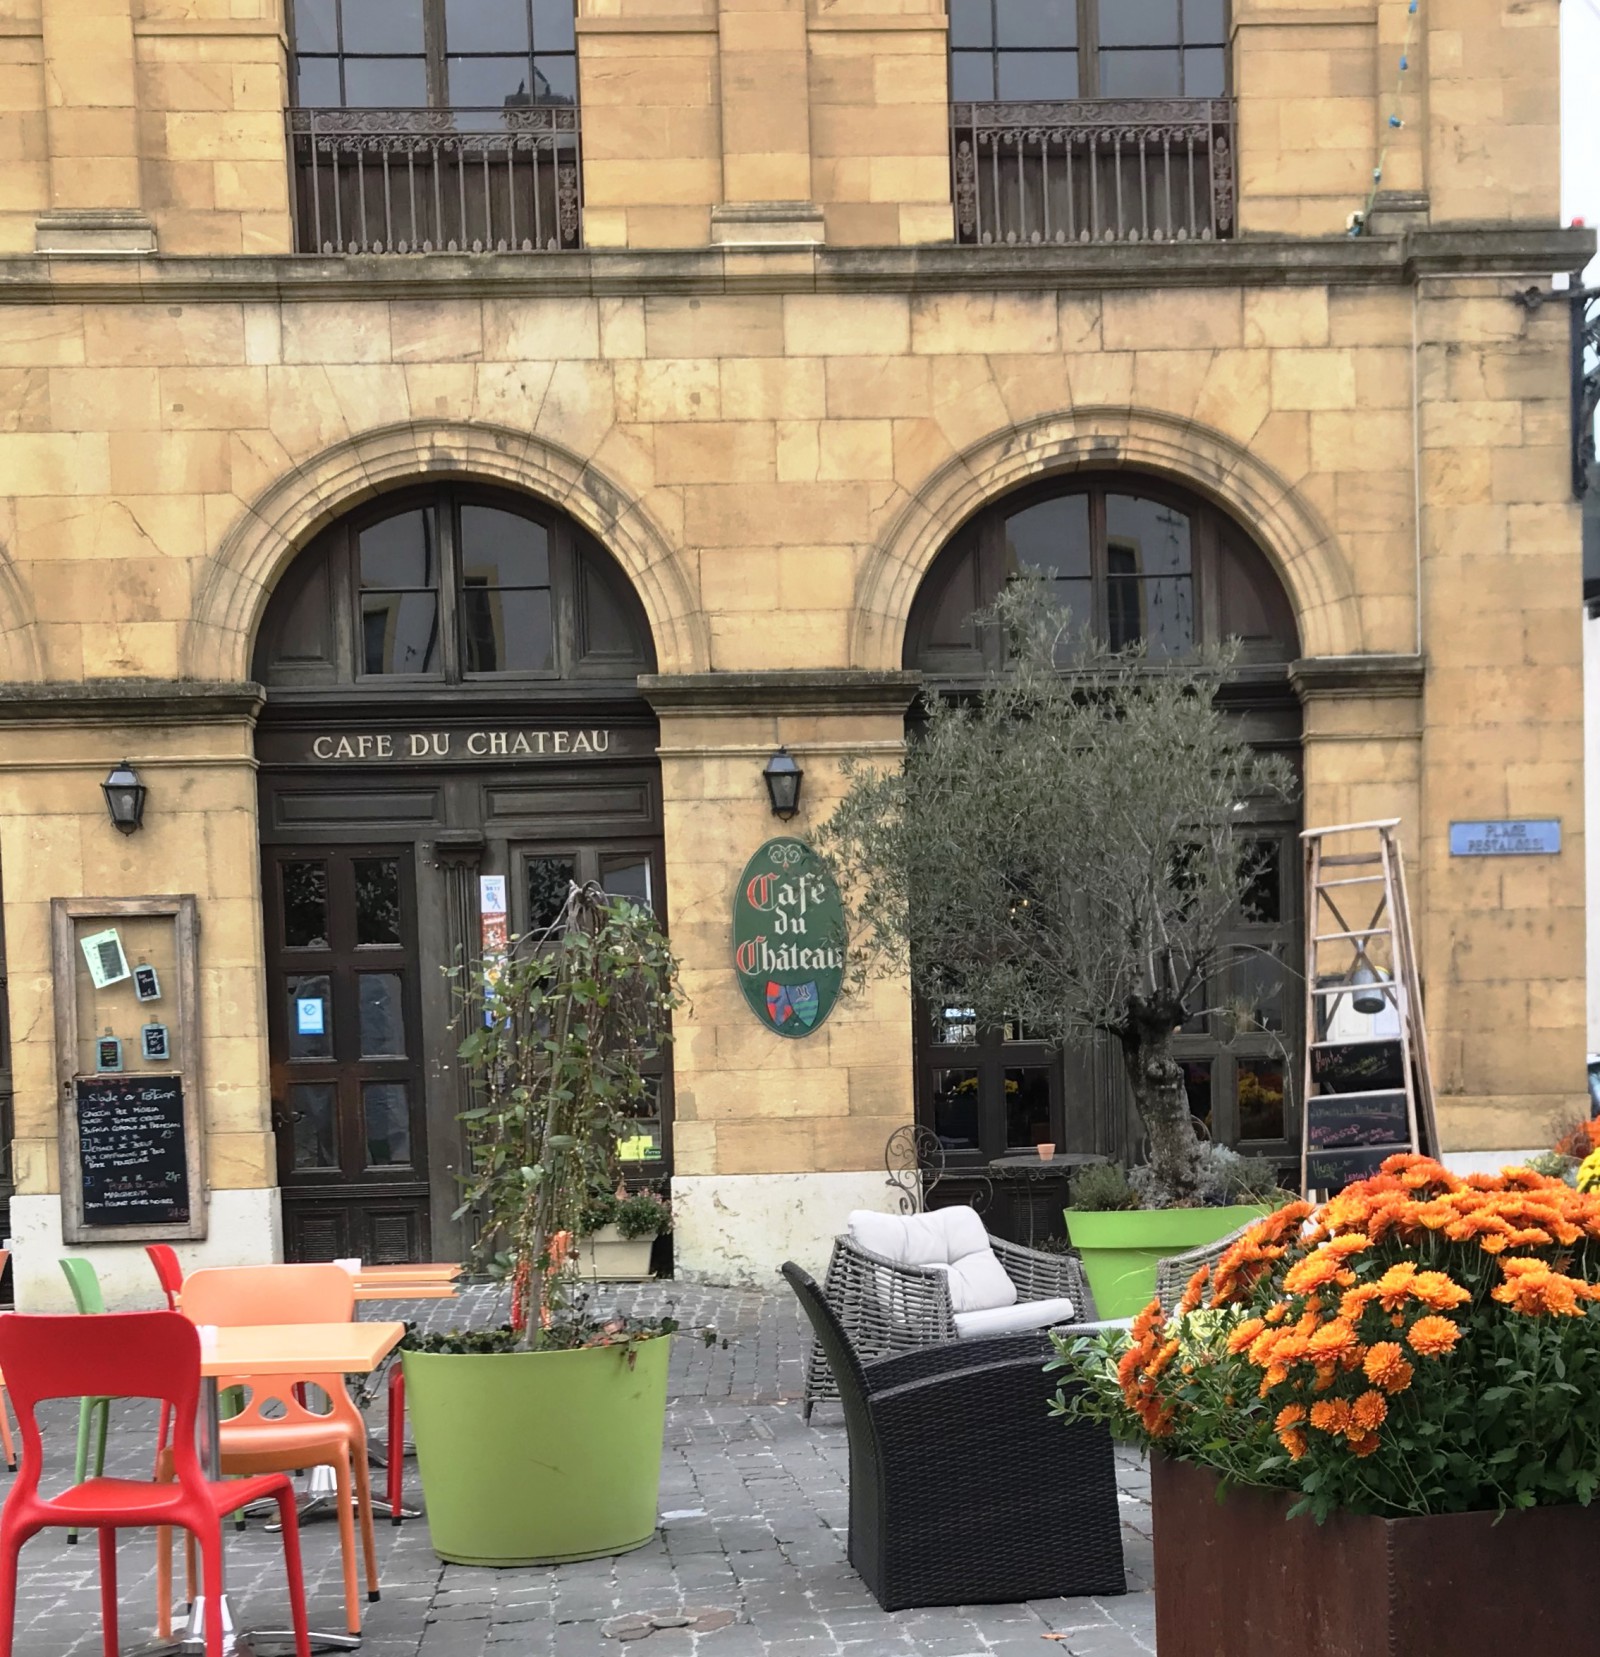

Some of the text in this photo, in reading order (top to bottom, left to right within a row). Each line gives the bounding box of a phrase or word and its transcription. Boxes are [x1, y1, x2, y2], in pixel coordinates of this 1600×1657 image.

[313, 730, 610, 759] CAFE DU CHATEAU
[746, 872, 825, 916] Café
[774, 906, 808, 935] du
[736, 936, 843, 976] Château
